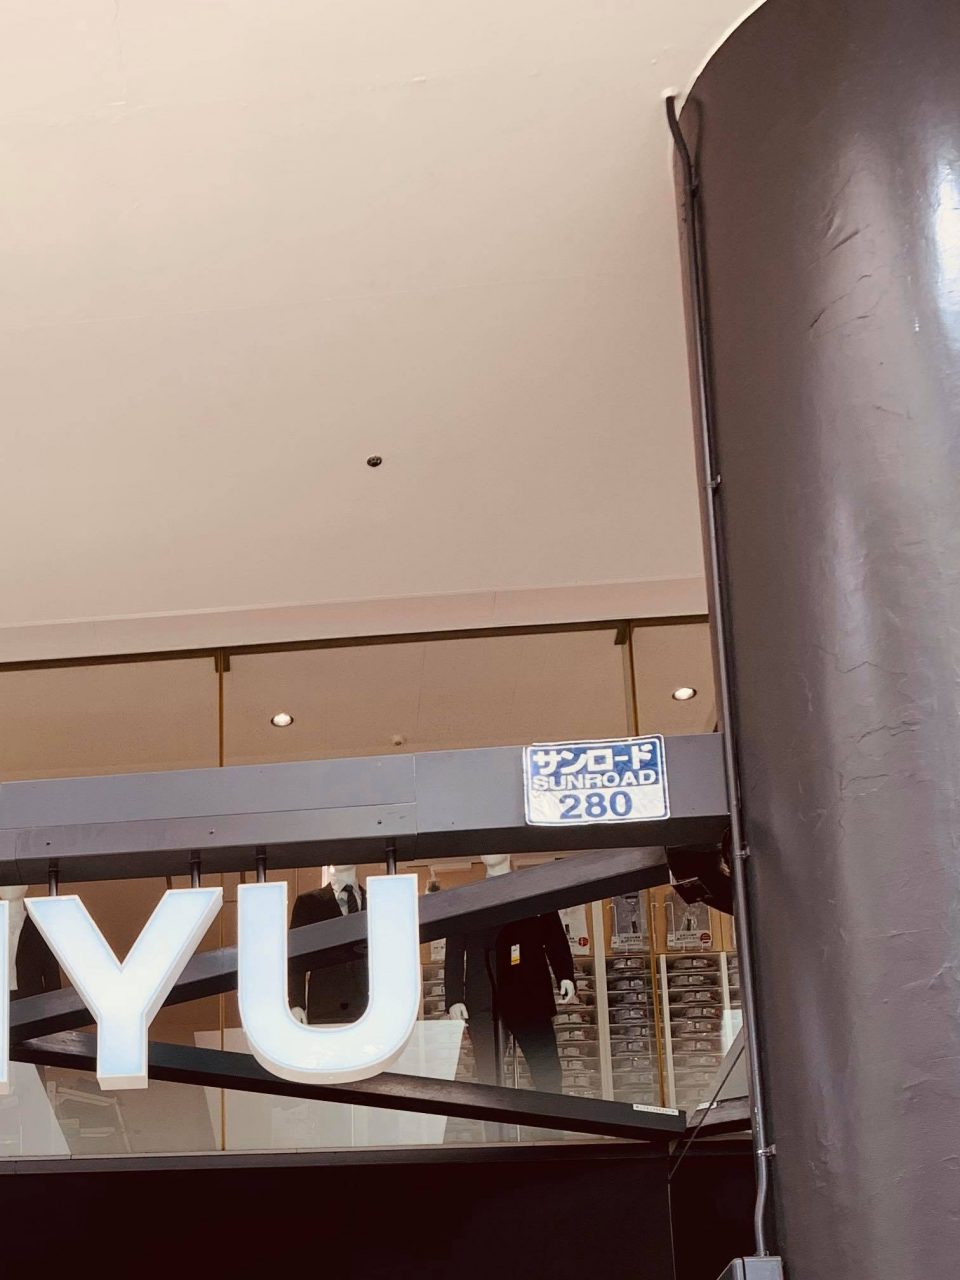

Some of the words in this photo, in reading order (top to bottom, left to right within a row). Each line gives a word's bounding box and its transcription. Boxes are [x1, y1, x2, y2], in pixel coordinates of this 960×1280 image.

[533, 743, 654, 776] サンロード
[532, 769, 657, 791] SUNROAD
[558, 790, 633, 820] 280
